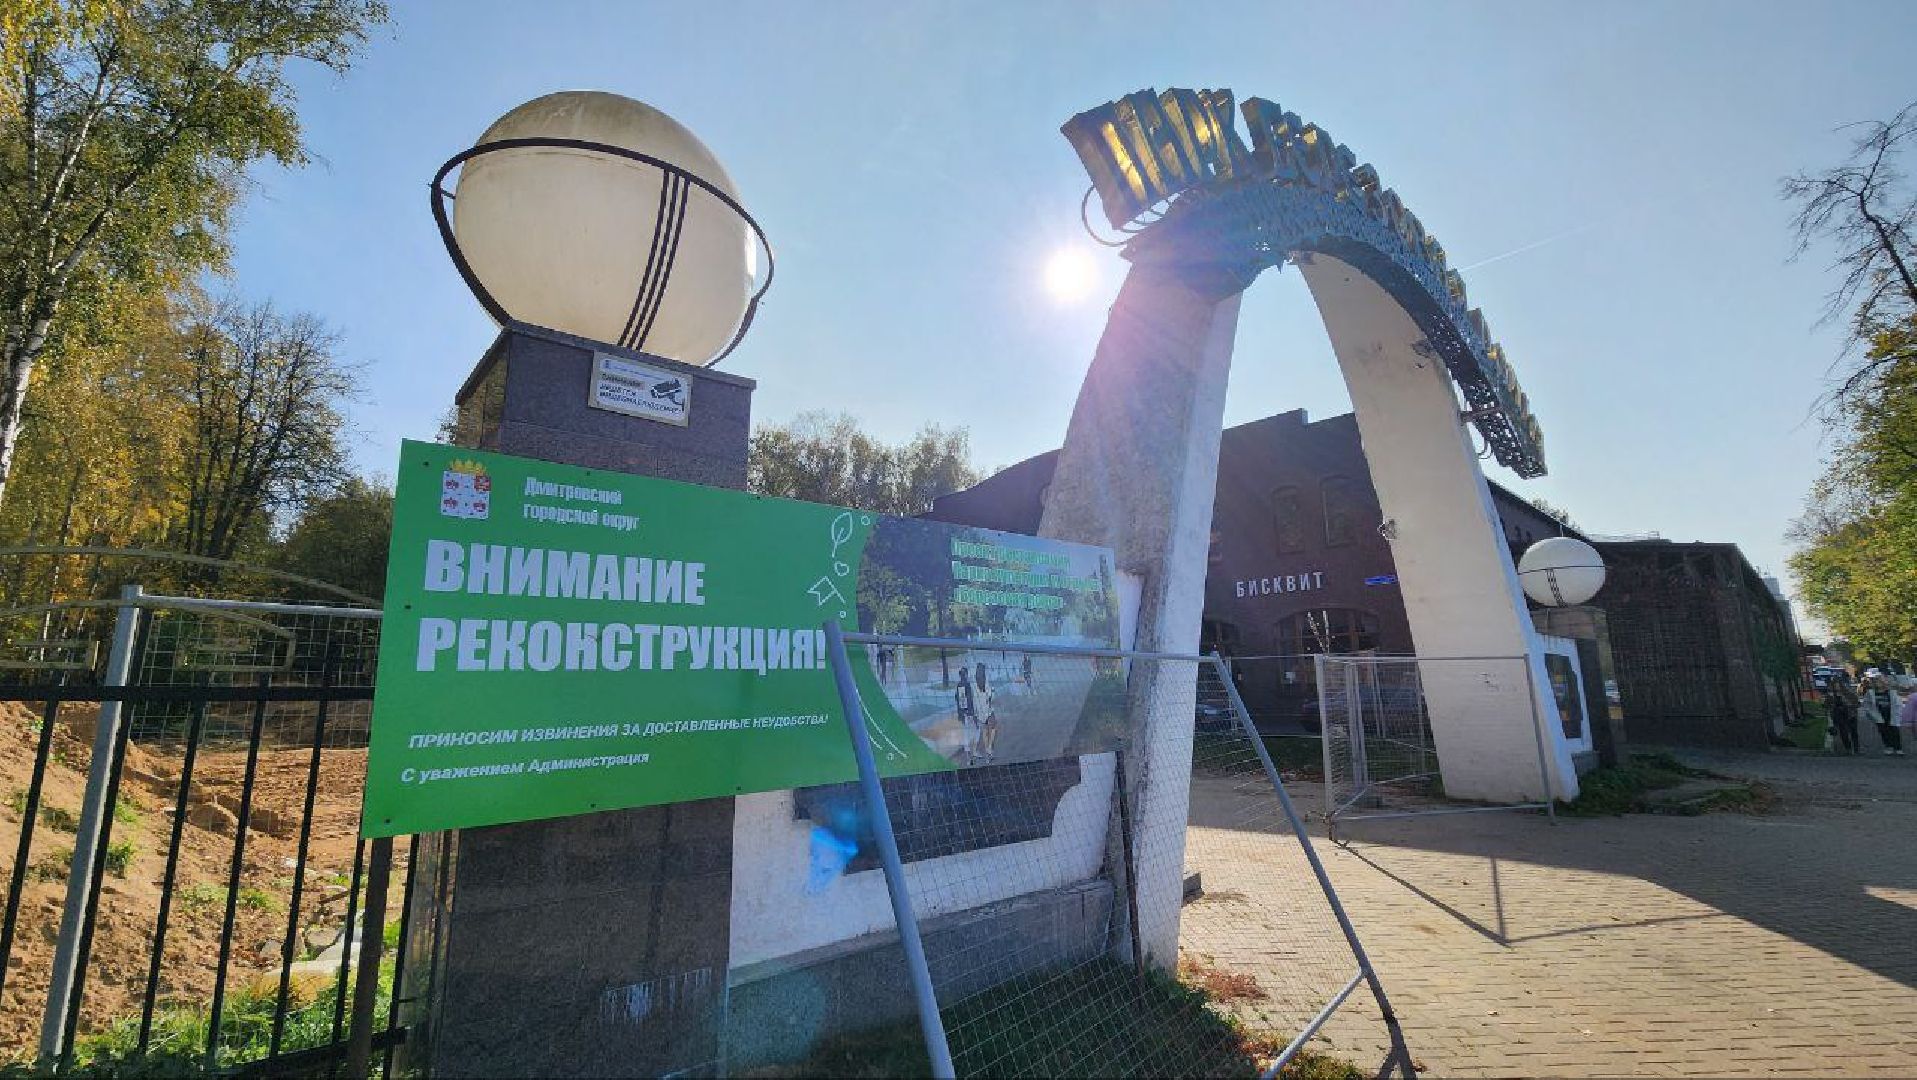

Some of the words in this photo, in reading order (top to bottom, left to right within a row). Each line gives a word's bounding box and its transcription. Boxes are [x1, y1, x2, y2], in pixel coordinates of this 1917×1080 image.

[524, 476, 622, 505] Дмитровский
[523, 503, 599, 526] городской
[602, 513, 640, 532] округ
[424, 539, 706, 606] ВНИМАНИЕ
[1236, 571, 1324, 598] БИСКВИТ
[416, 617, 827, 677] РЕКОНСТРУКЦИЯ!
[407, 728, 518, 749] ПРИНОСИМ
[520, 722, 619, 742] ИЗВИНЕНИЯ
[620, 721, 641, 737] ЗА
[643, 716, 751, 736] ДОСТАВЛЕННЫЕ
[752, 713, 829, 729] НЕУДОБСТВА!
[400, 768, 415, 783] С
[418, 762, 524, 784] уважением
[526, 751, 650, 774] Администрация
